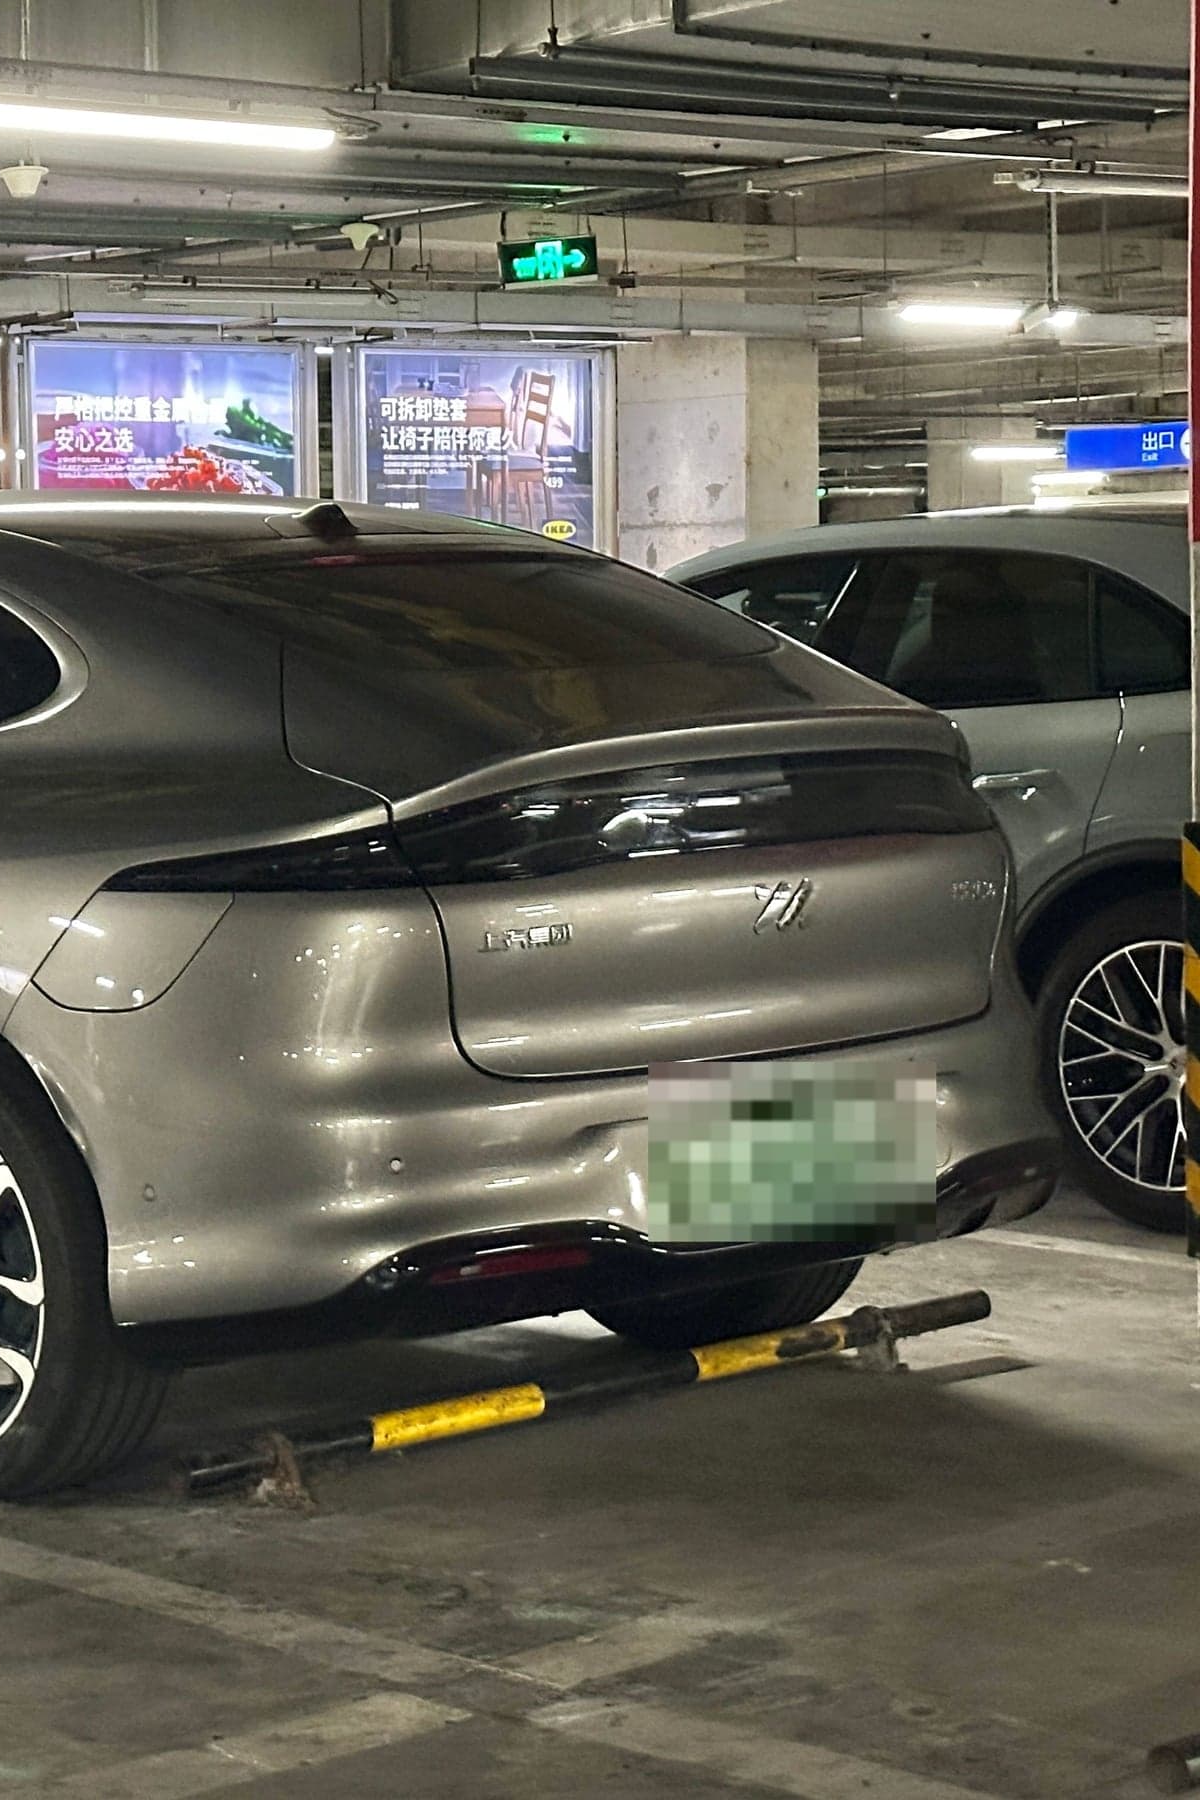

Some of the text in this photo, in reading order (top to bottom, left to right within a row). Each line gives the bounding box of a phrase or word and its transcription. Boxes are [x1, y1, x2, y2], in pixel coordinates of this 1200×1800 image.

[380, 397, 467, 422] 可拆卸垫套
[54, 426, 134, 453] 安心之选
[381, 426, 518, 451] 让椅子陪伴你更久
[1142, 431, 1174, 451] 出口
[545, 525, 574, 534] IKEA
[478, 922, 574, 953] 上汽集团
